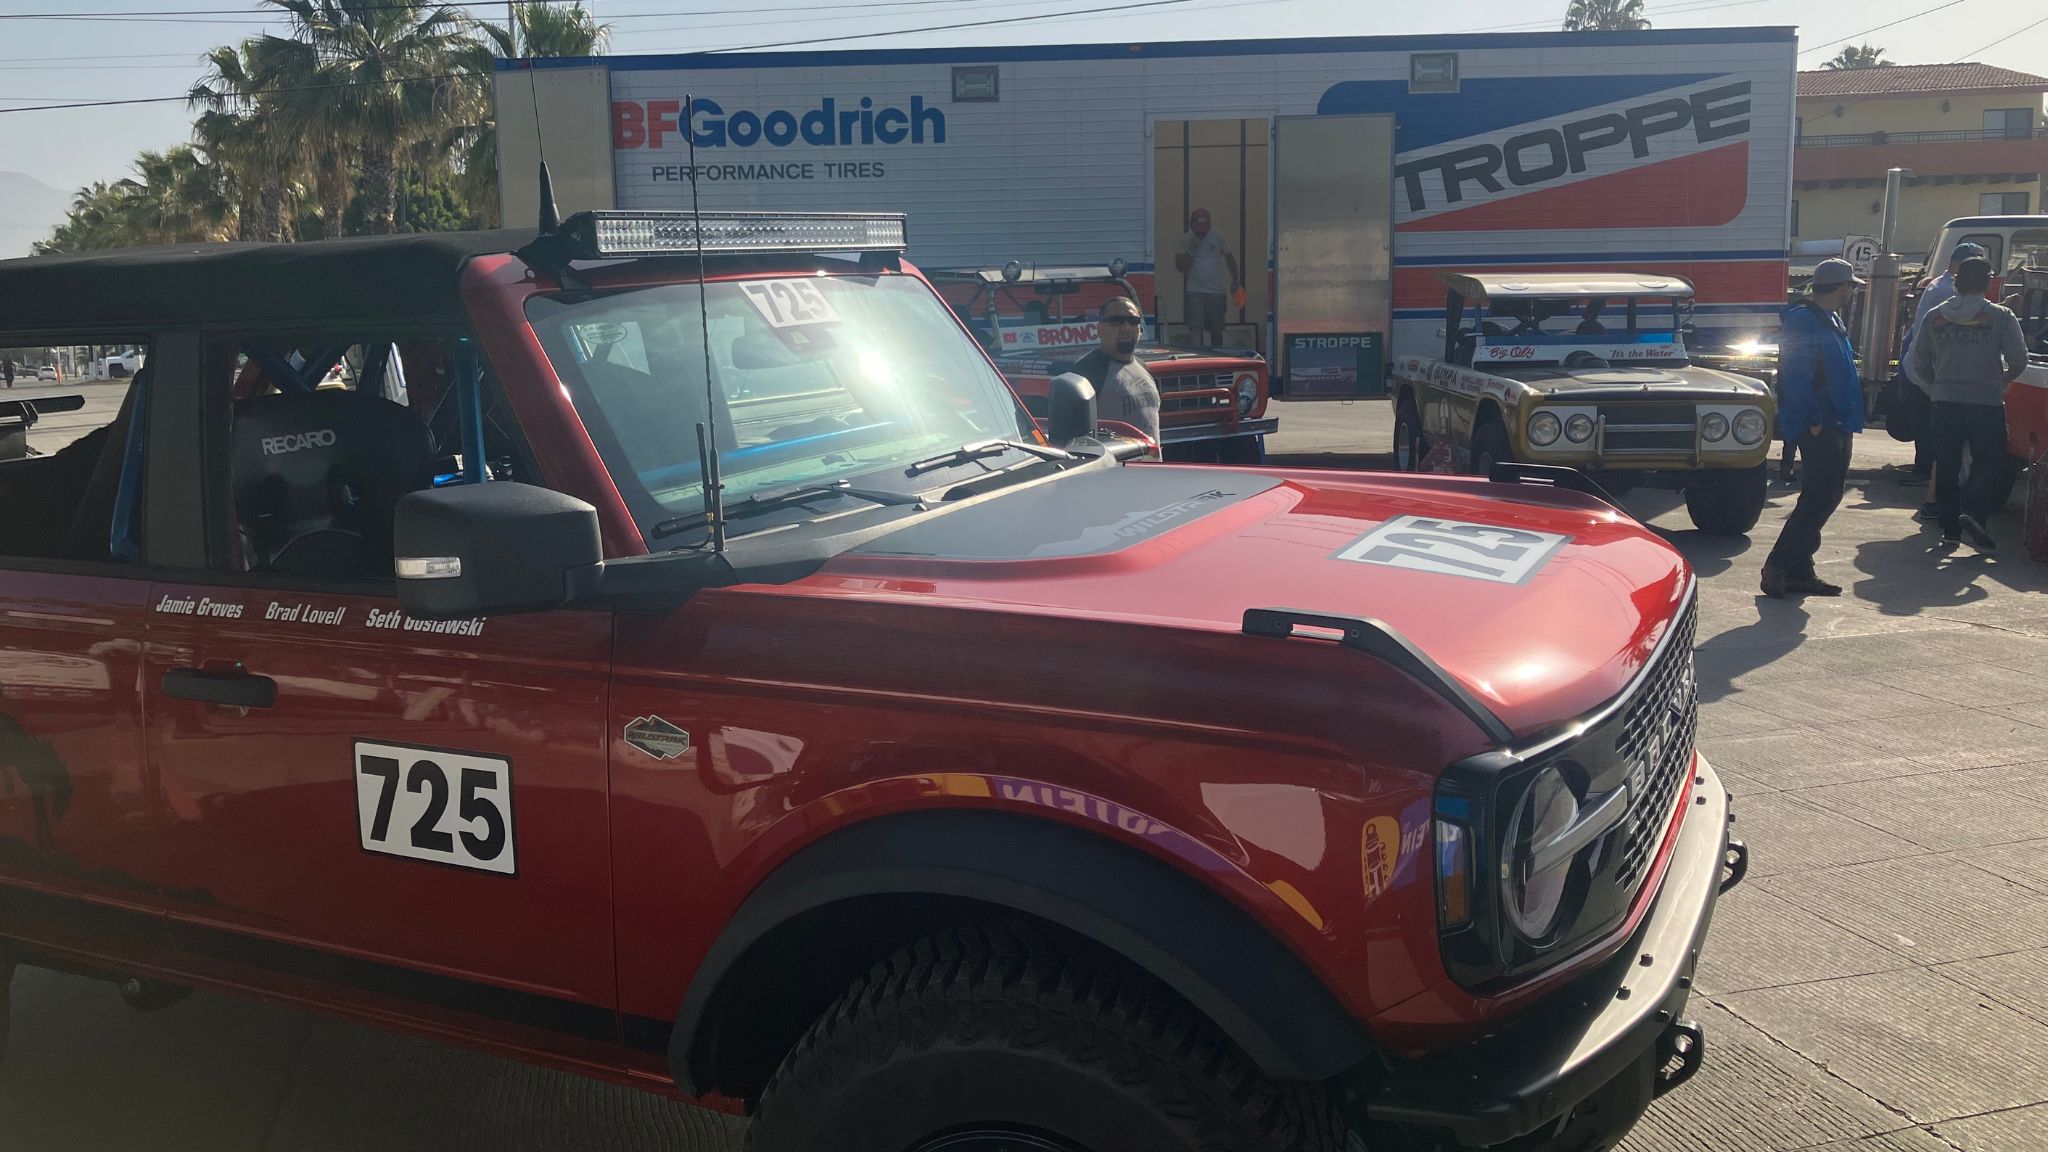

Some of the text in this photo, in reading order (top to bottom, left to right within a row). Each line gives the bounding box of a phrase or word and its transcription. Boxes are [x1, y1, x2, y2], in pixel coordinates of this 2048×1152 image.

[612, 96, 946, 149] BFGoodrich
[1394, 80, 1751, 212] TROPPE
[652, 162, 885, 182] PERFORMANCE TIRES
[1855, 246, 1871, 262] 15
[745, 281, 828, 323] 725
[1037, 321, 1102, 346] BRONC
[1294, 336, 1372, 349] STROPPE
[1628, 349, 1643, 358] the
[261, 429, 336, 455] RECARO
[1358, 519, 1545, 578] 725
[155, 594, 195, 615] Jamie
[196, 597, 244, 619] Groves
[264, 601, 301, 622] Brad
[301, 605, 346, 626] Lovell
[366, 608, 402, 630] Seth
[360, 754, 506, 861] 725
